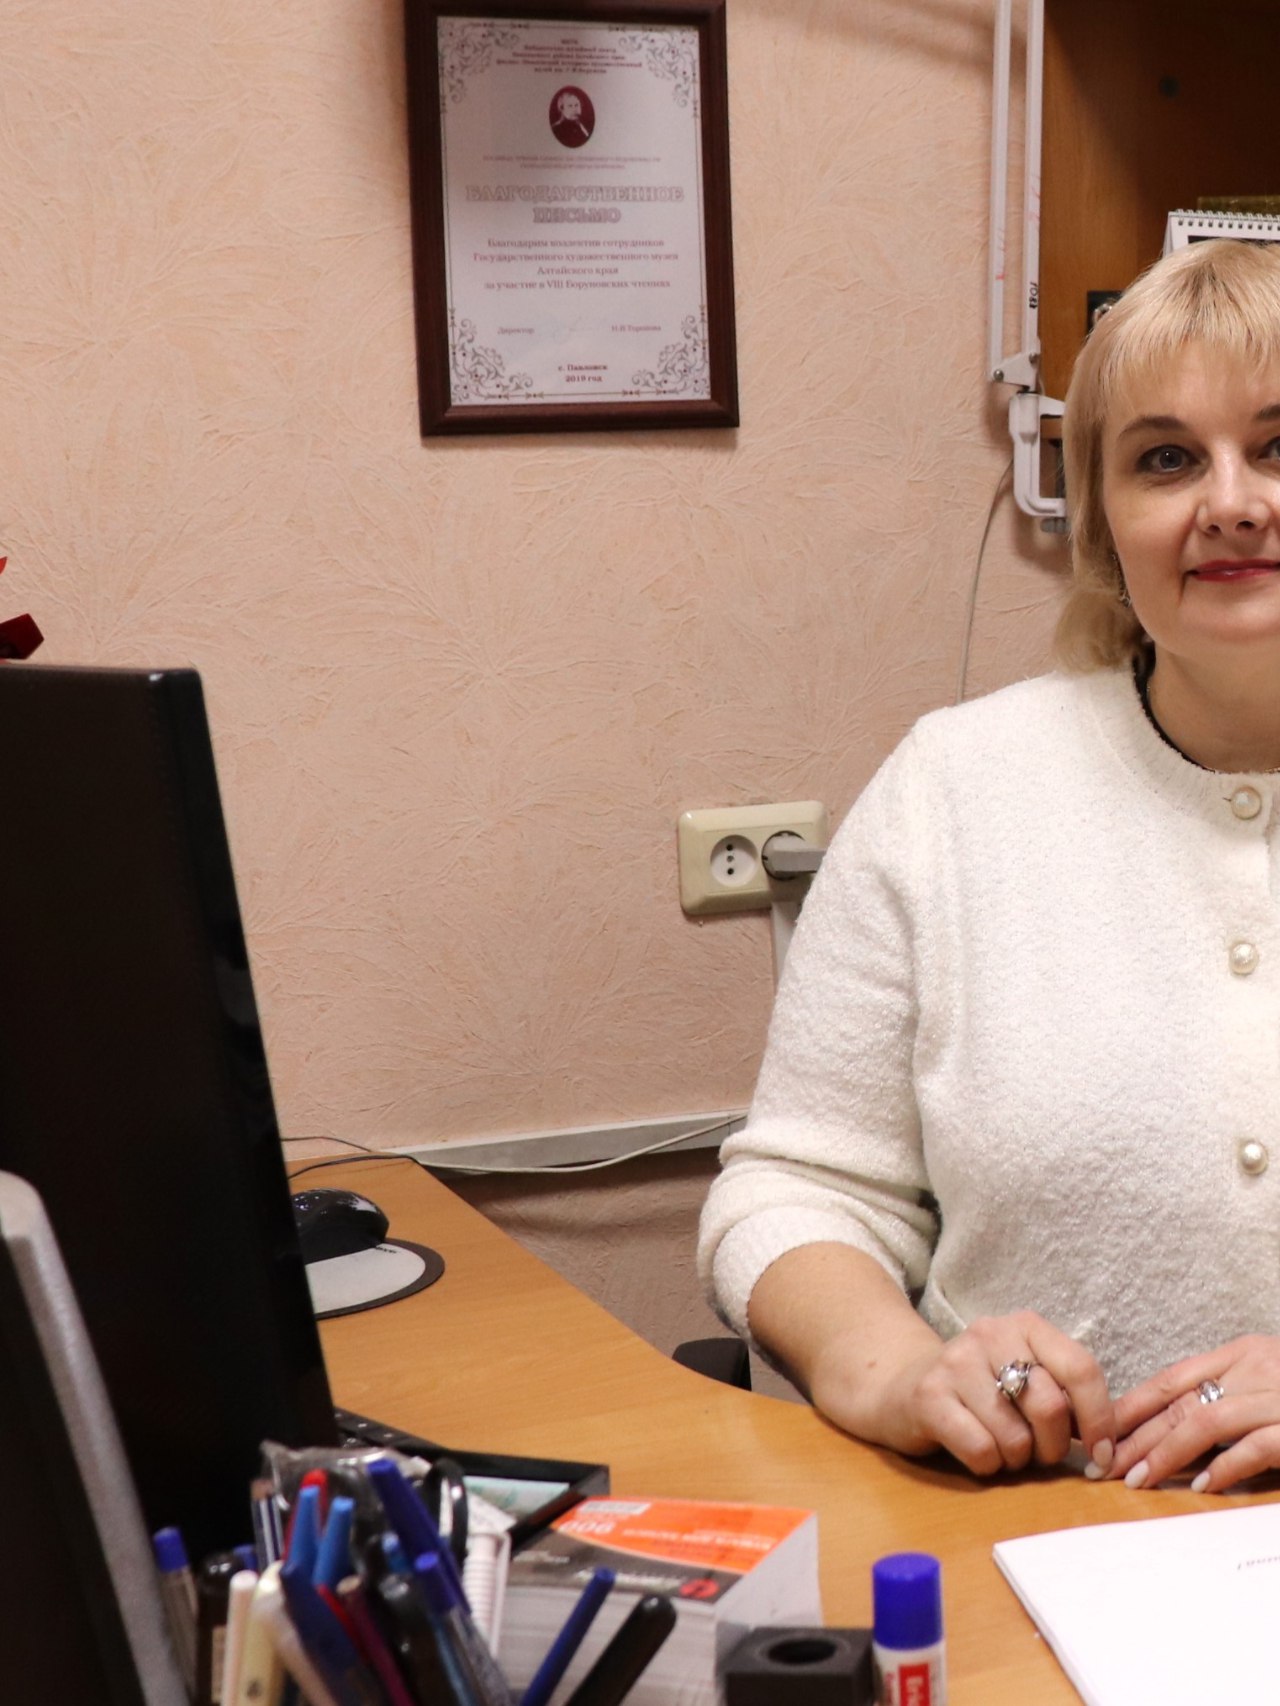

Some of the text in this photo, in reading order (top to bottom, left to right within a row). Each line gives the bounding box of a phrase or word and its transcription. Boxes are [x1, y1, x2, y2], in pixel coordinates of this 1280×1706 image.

[465, 185, 684, 203] БЛАГОДАРСТВЕННОЕ
[532, 207, 622, 224] ПИСЬМО
[487, 237, 548, 249] Благодарим
[602, 239, 665, 250] сотрудников
[473, 252, 564, 263] Государственного
[566, 252, 649, 263] художественного
[537, 265, 619, 277] Алтайского края
